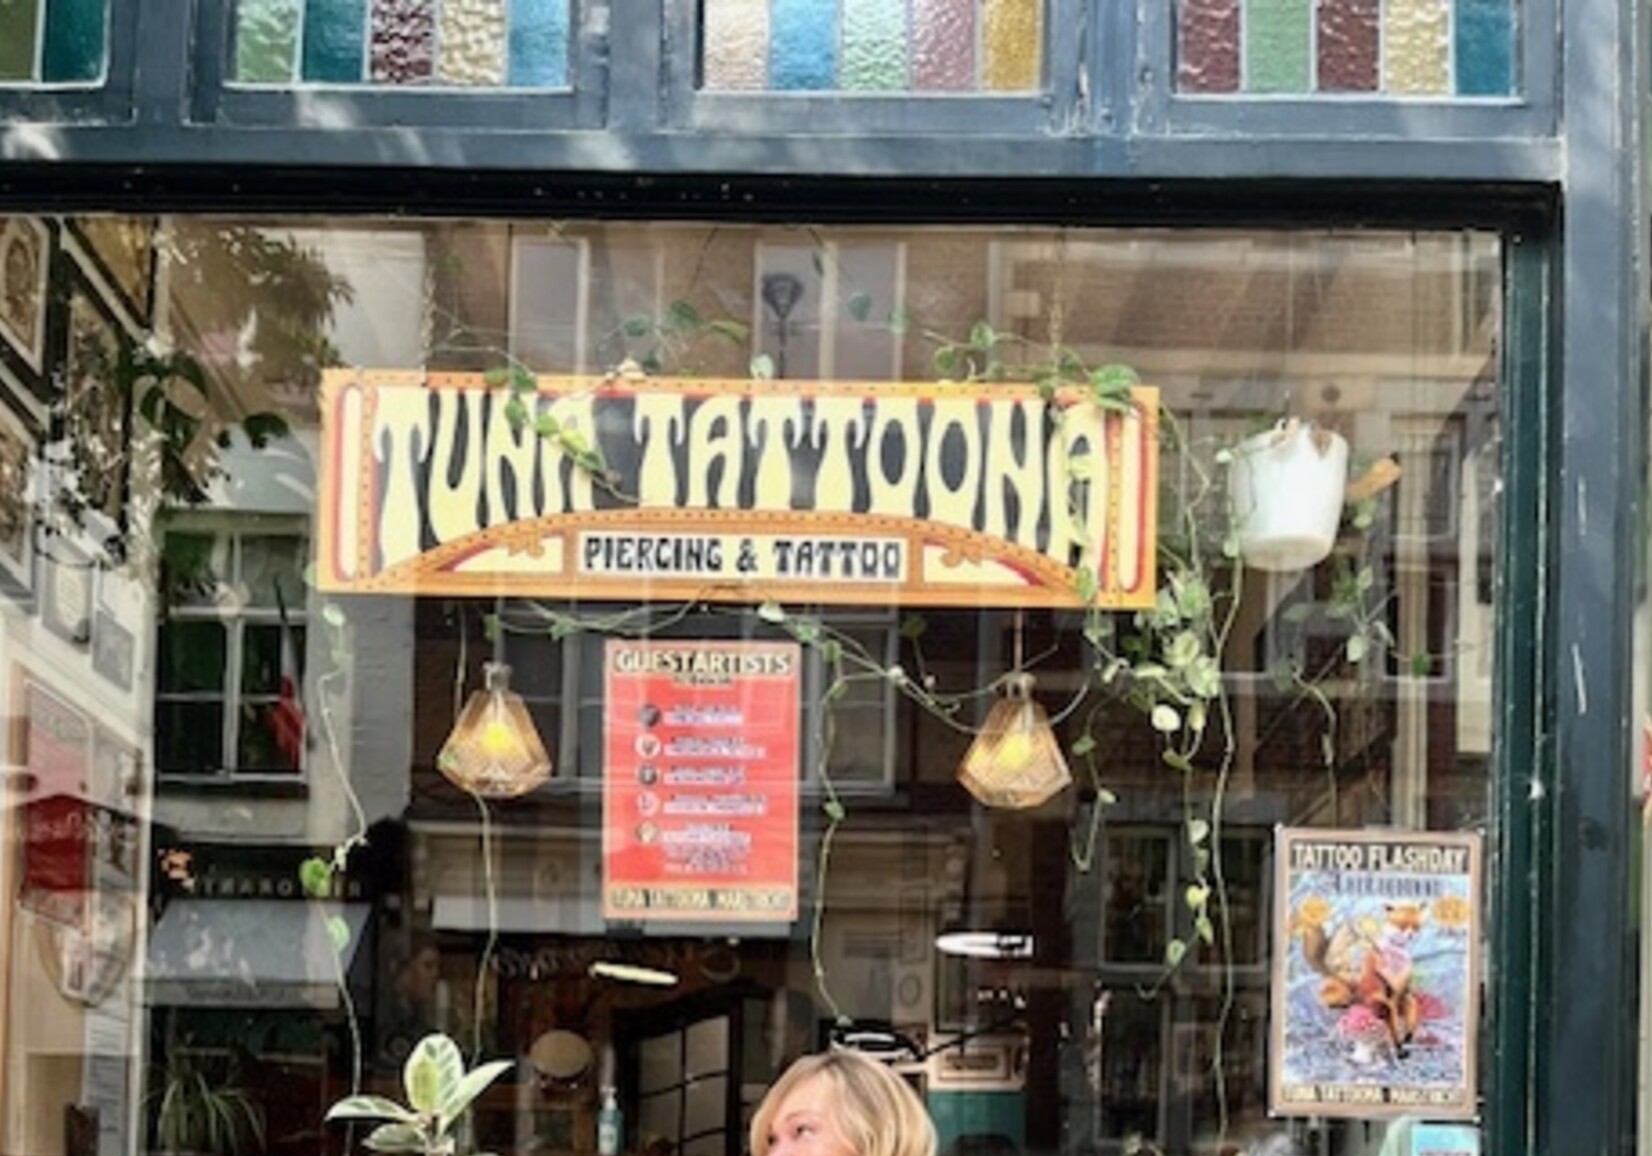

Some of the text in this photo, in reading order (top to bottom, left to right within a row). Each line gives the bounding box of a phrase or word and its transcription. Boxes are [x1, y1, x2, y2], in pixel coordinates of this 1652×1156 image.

[374, 386, 1108, 592] TUNA TATTOONA
[584, 536, 902, 578] PIERCING & TATTOO
[1292, 843, 1467, 875] TATTOO FLASHDAY
